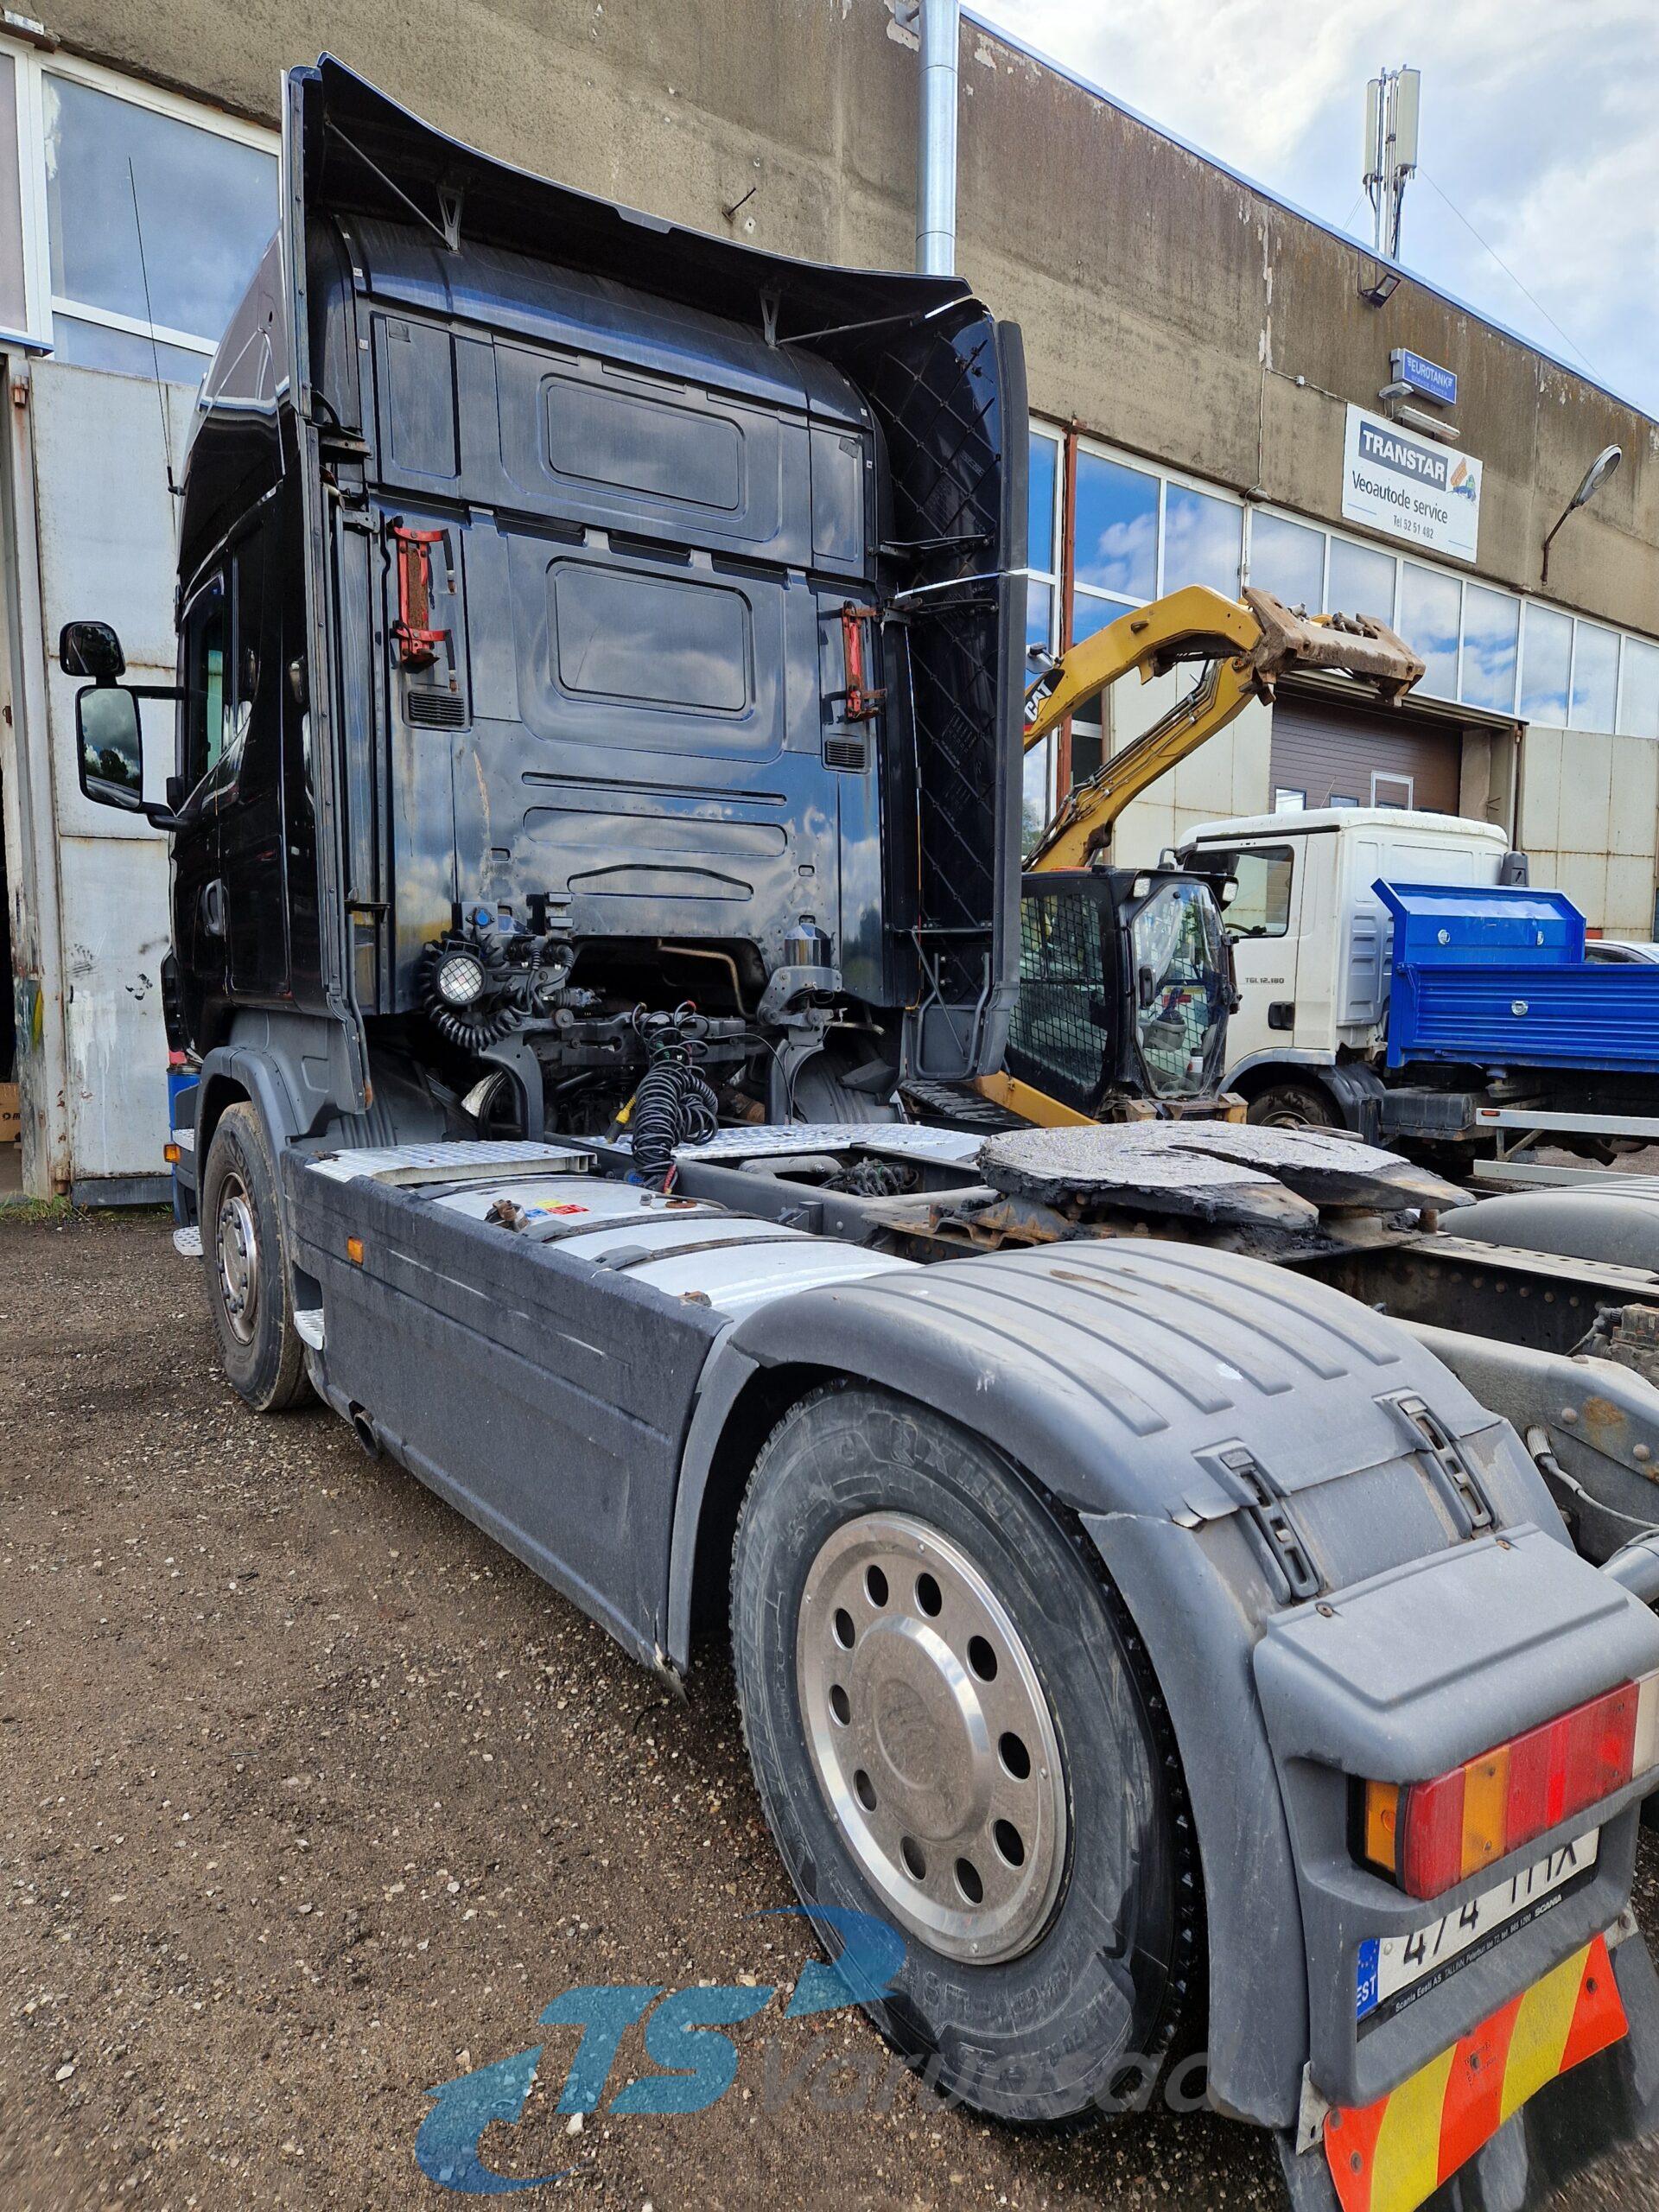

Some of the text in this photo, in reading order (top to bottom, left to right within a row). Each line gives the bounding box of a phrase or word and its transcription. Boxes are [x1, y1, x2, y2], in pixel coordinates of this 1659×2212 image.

[1411, 359, 1448, 389] EUROTANK
[1363, 429, 1445, 482] TRANSTAR
[1352, 470, 1448, 524] Veoautode service
[1393, 514, 1434, 539] Tel 52 51 482
[1024, 679, 1052, 721] CAT
[1395, 1993, 1416, 2012] Scania
[1433, 1974, 1442, 1986] AS
[1535, 1894, 1562, 1917] SCANIA
